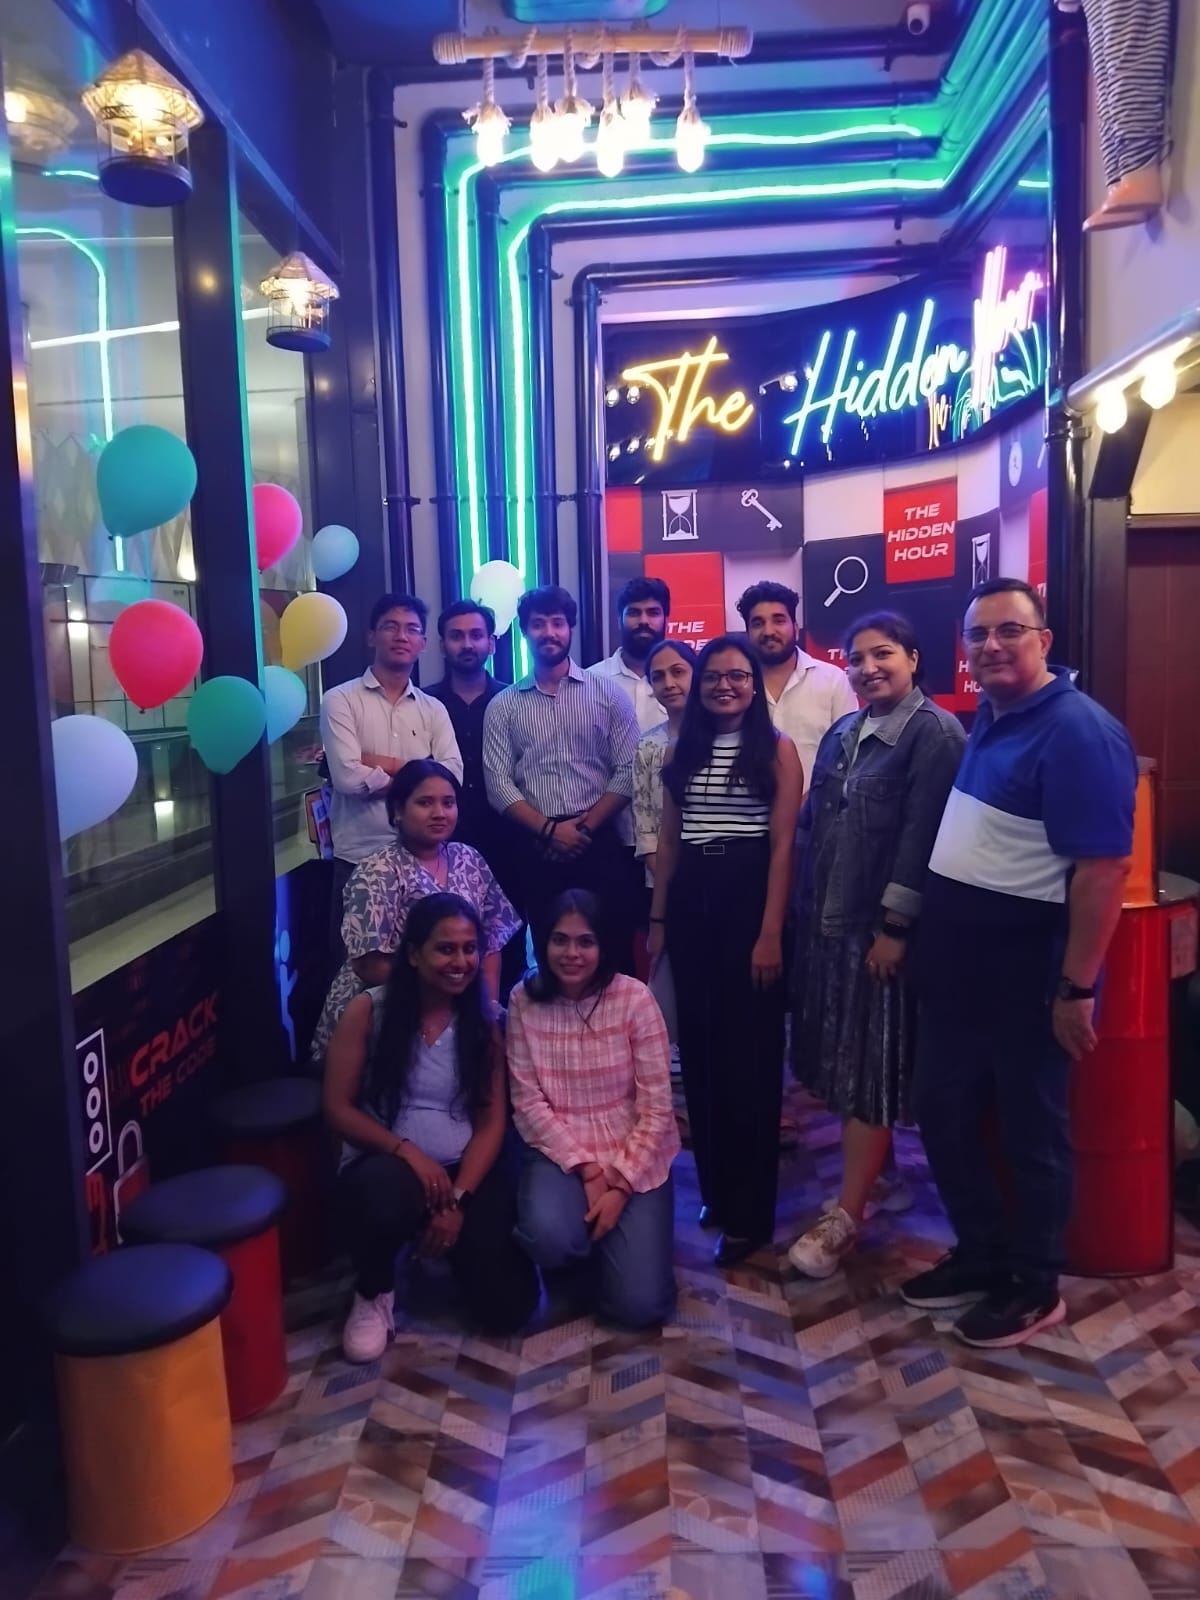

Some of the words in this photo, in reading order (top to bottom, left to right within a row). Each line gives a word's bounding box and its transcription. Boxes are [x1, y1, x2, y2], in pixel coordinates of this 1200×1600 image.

[622, 335, 754, 461] The
[904, 503, 941, 521] THE
[887, 520, 956, 543] HIDDEN
[893, 542, 949, 562] HOUR
[667, 620, 705, 634] THE
[129, 991, 219, 1087] CRACK
[139, 1072, 172, 1117] THE
